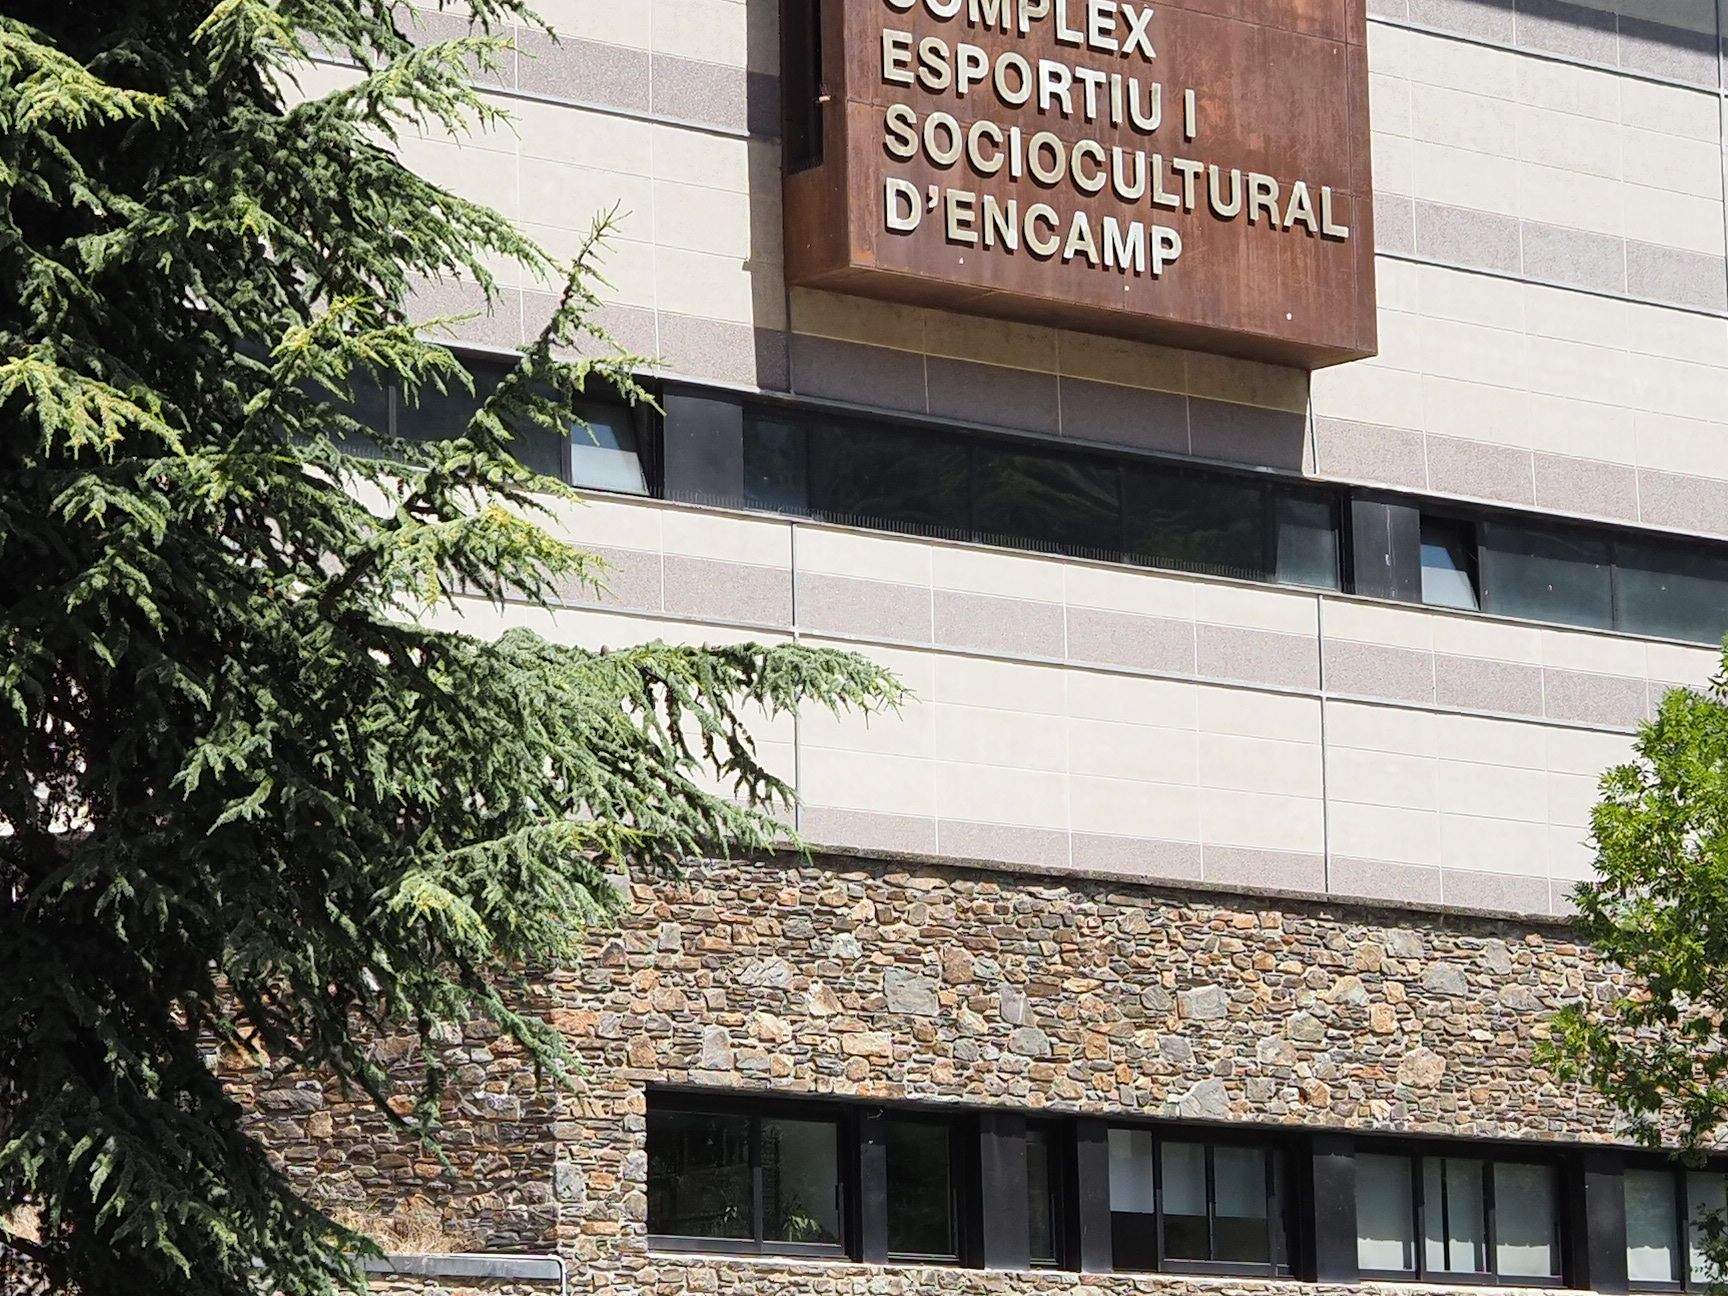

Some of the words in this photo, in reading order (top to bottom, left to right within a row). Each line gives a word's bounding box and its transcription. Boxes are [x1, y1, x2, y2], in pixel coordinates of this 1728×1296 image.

[882, 29, 1161, 131] ESPORTIU
[1184, 90, 1196, 138] I
[884, 105, 1349, 238] SOCIOCULTURAL
[885, 177, 1182, 275] D'ENCAMP
